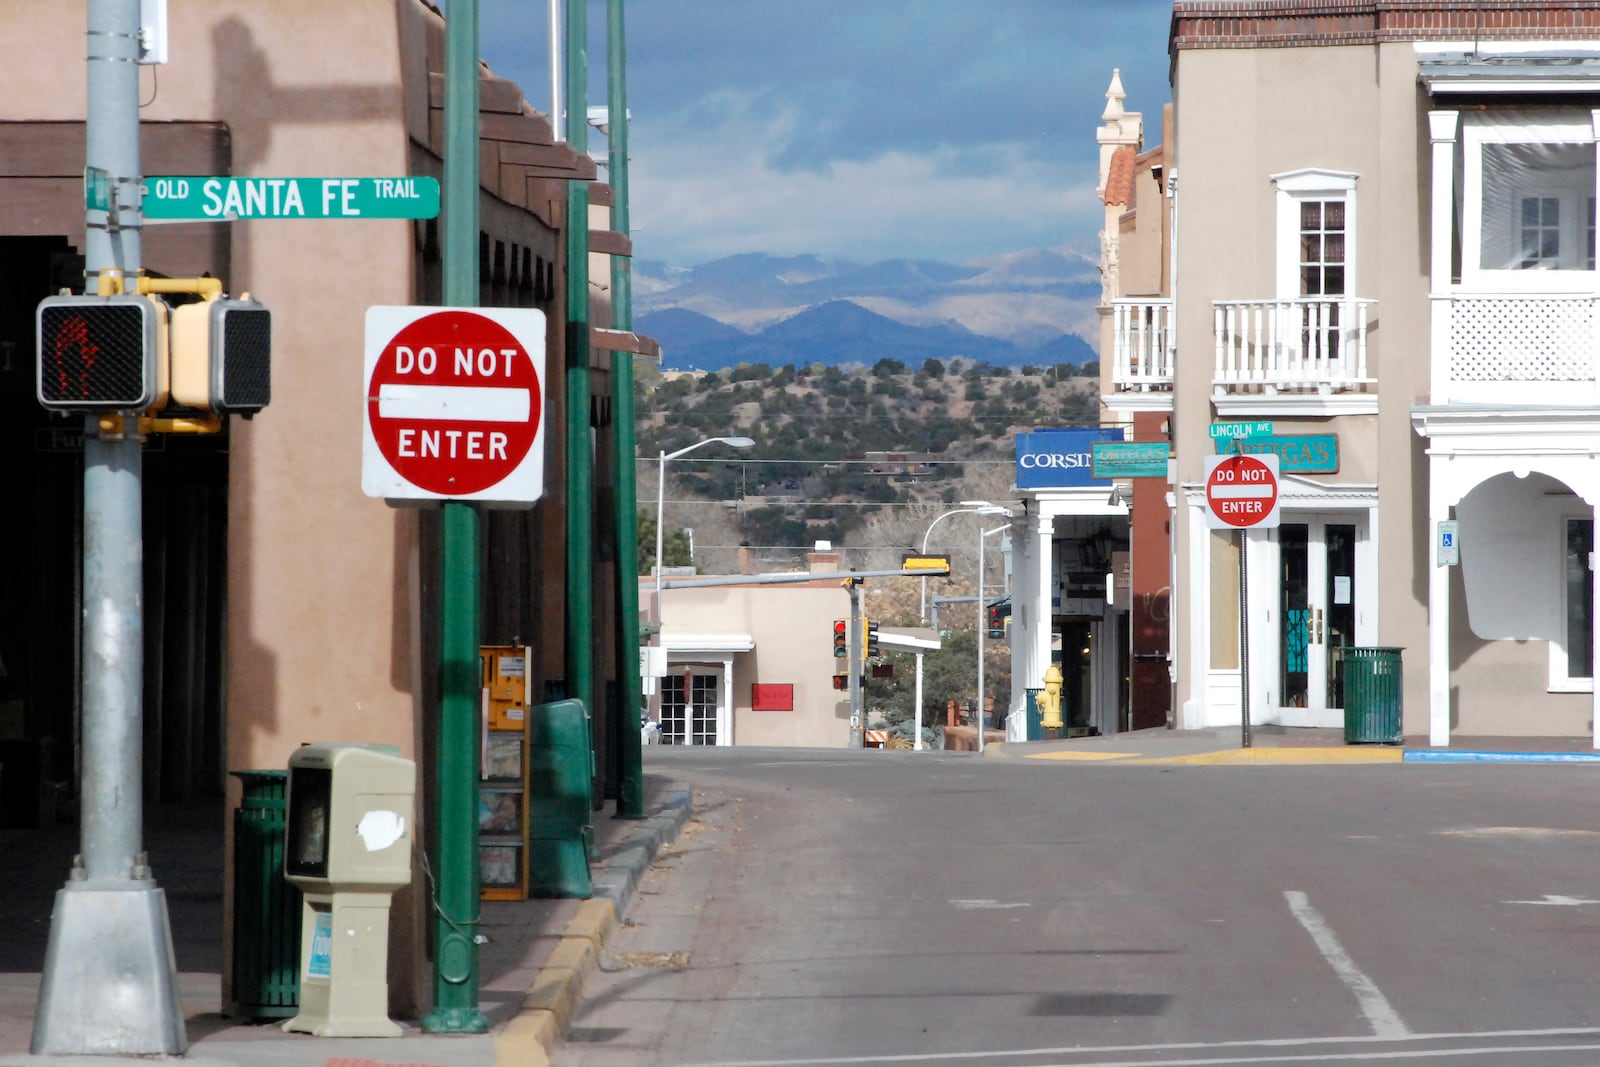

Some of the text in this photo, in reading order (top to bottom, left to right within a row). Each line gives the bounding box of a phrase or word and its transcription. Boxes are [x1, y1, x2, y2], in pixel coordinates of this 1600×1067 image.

[155, 179, 420, 216] OLD SANTA FE TRAIL
[395, 346, 517, 377] DO NOT
[1210, 423, 1270, 437] LINCOLN AVE
[398, 429, 508, 460] ENTER
[1216, 469, 1267, 481] DO NOT
[1222, 501, 1262, 513] ENTER
